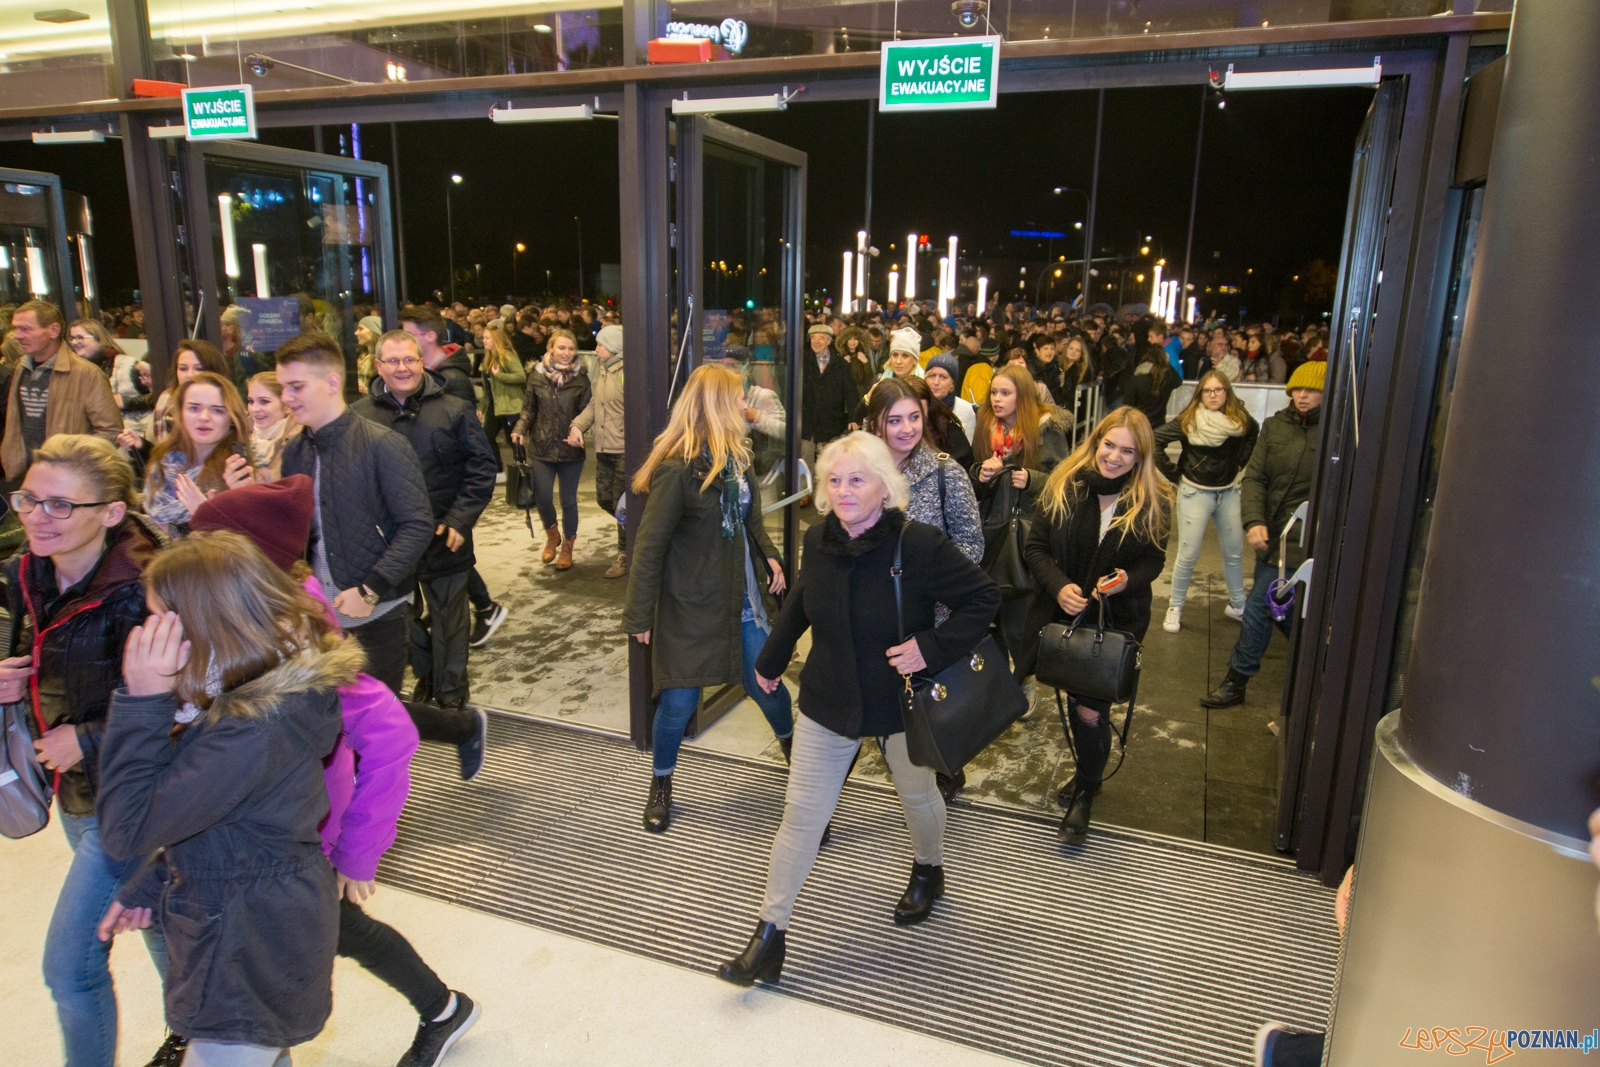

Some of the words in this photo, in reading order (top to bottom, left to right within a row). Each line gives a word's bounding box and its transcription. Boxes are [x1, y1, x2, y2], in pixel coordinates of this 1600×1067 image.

[898, 55, 982, 76] WYJŚCIE
[891, 79, 986, 95] EWAKUACYJNE
[193, 98, 241, 114] WYJŚCIE
[191, 116, 246, 129] EWAKUACYJNE
